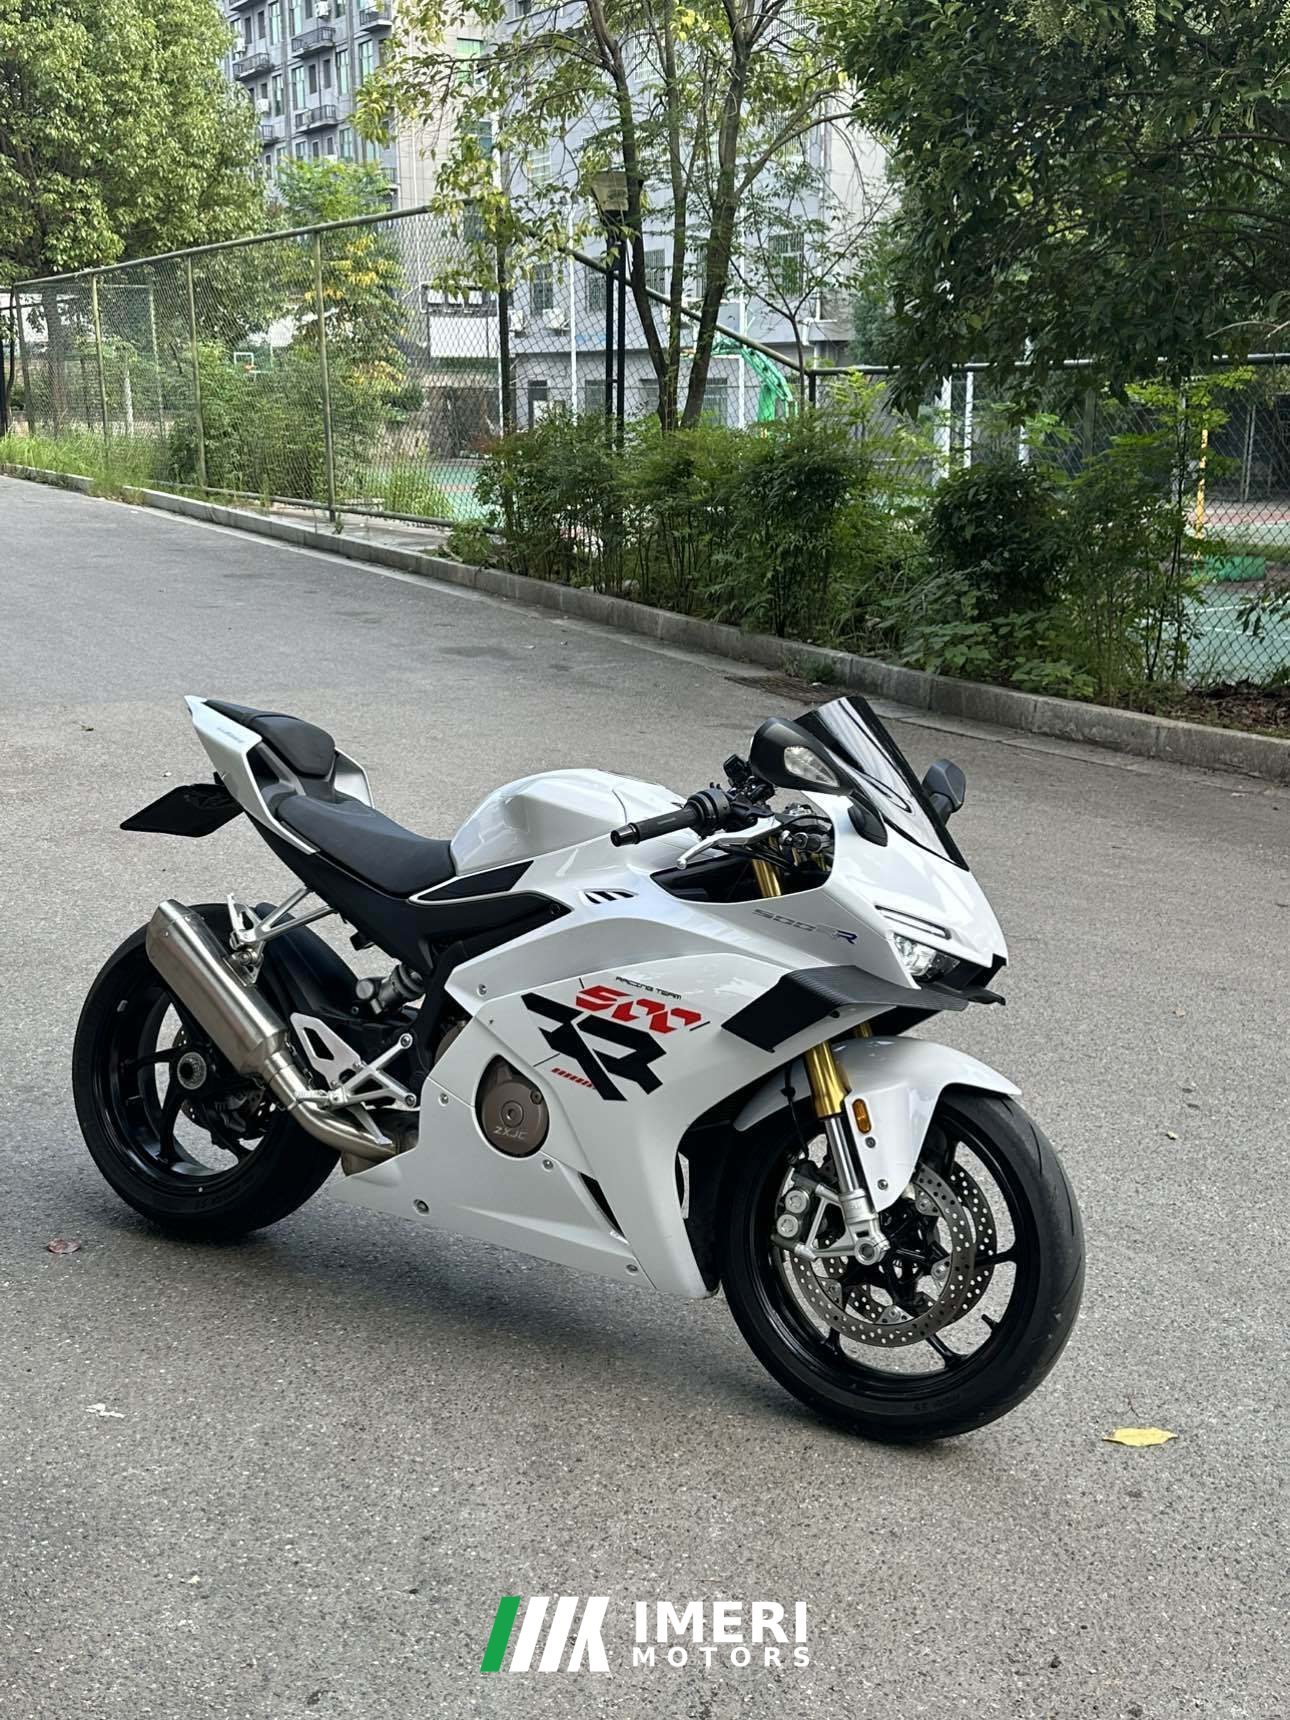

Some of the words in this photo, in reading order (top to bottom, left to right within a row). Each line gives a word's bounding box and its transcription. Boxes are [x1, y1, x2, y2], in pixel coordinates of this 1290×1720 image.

[616, 976, 654, 992] RACING
[656, 987, 682, 1000] TEAM
[575, 984, 702, 1034] 500
